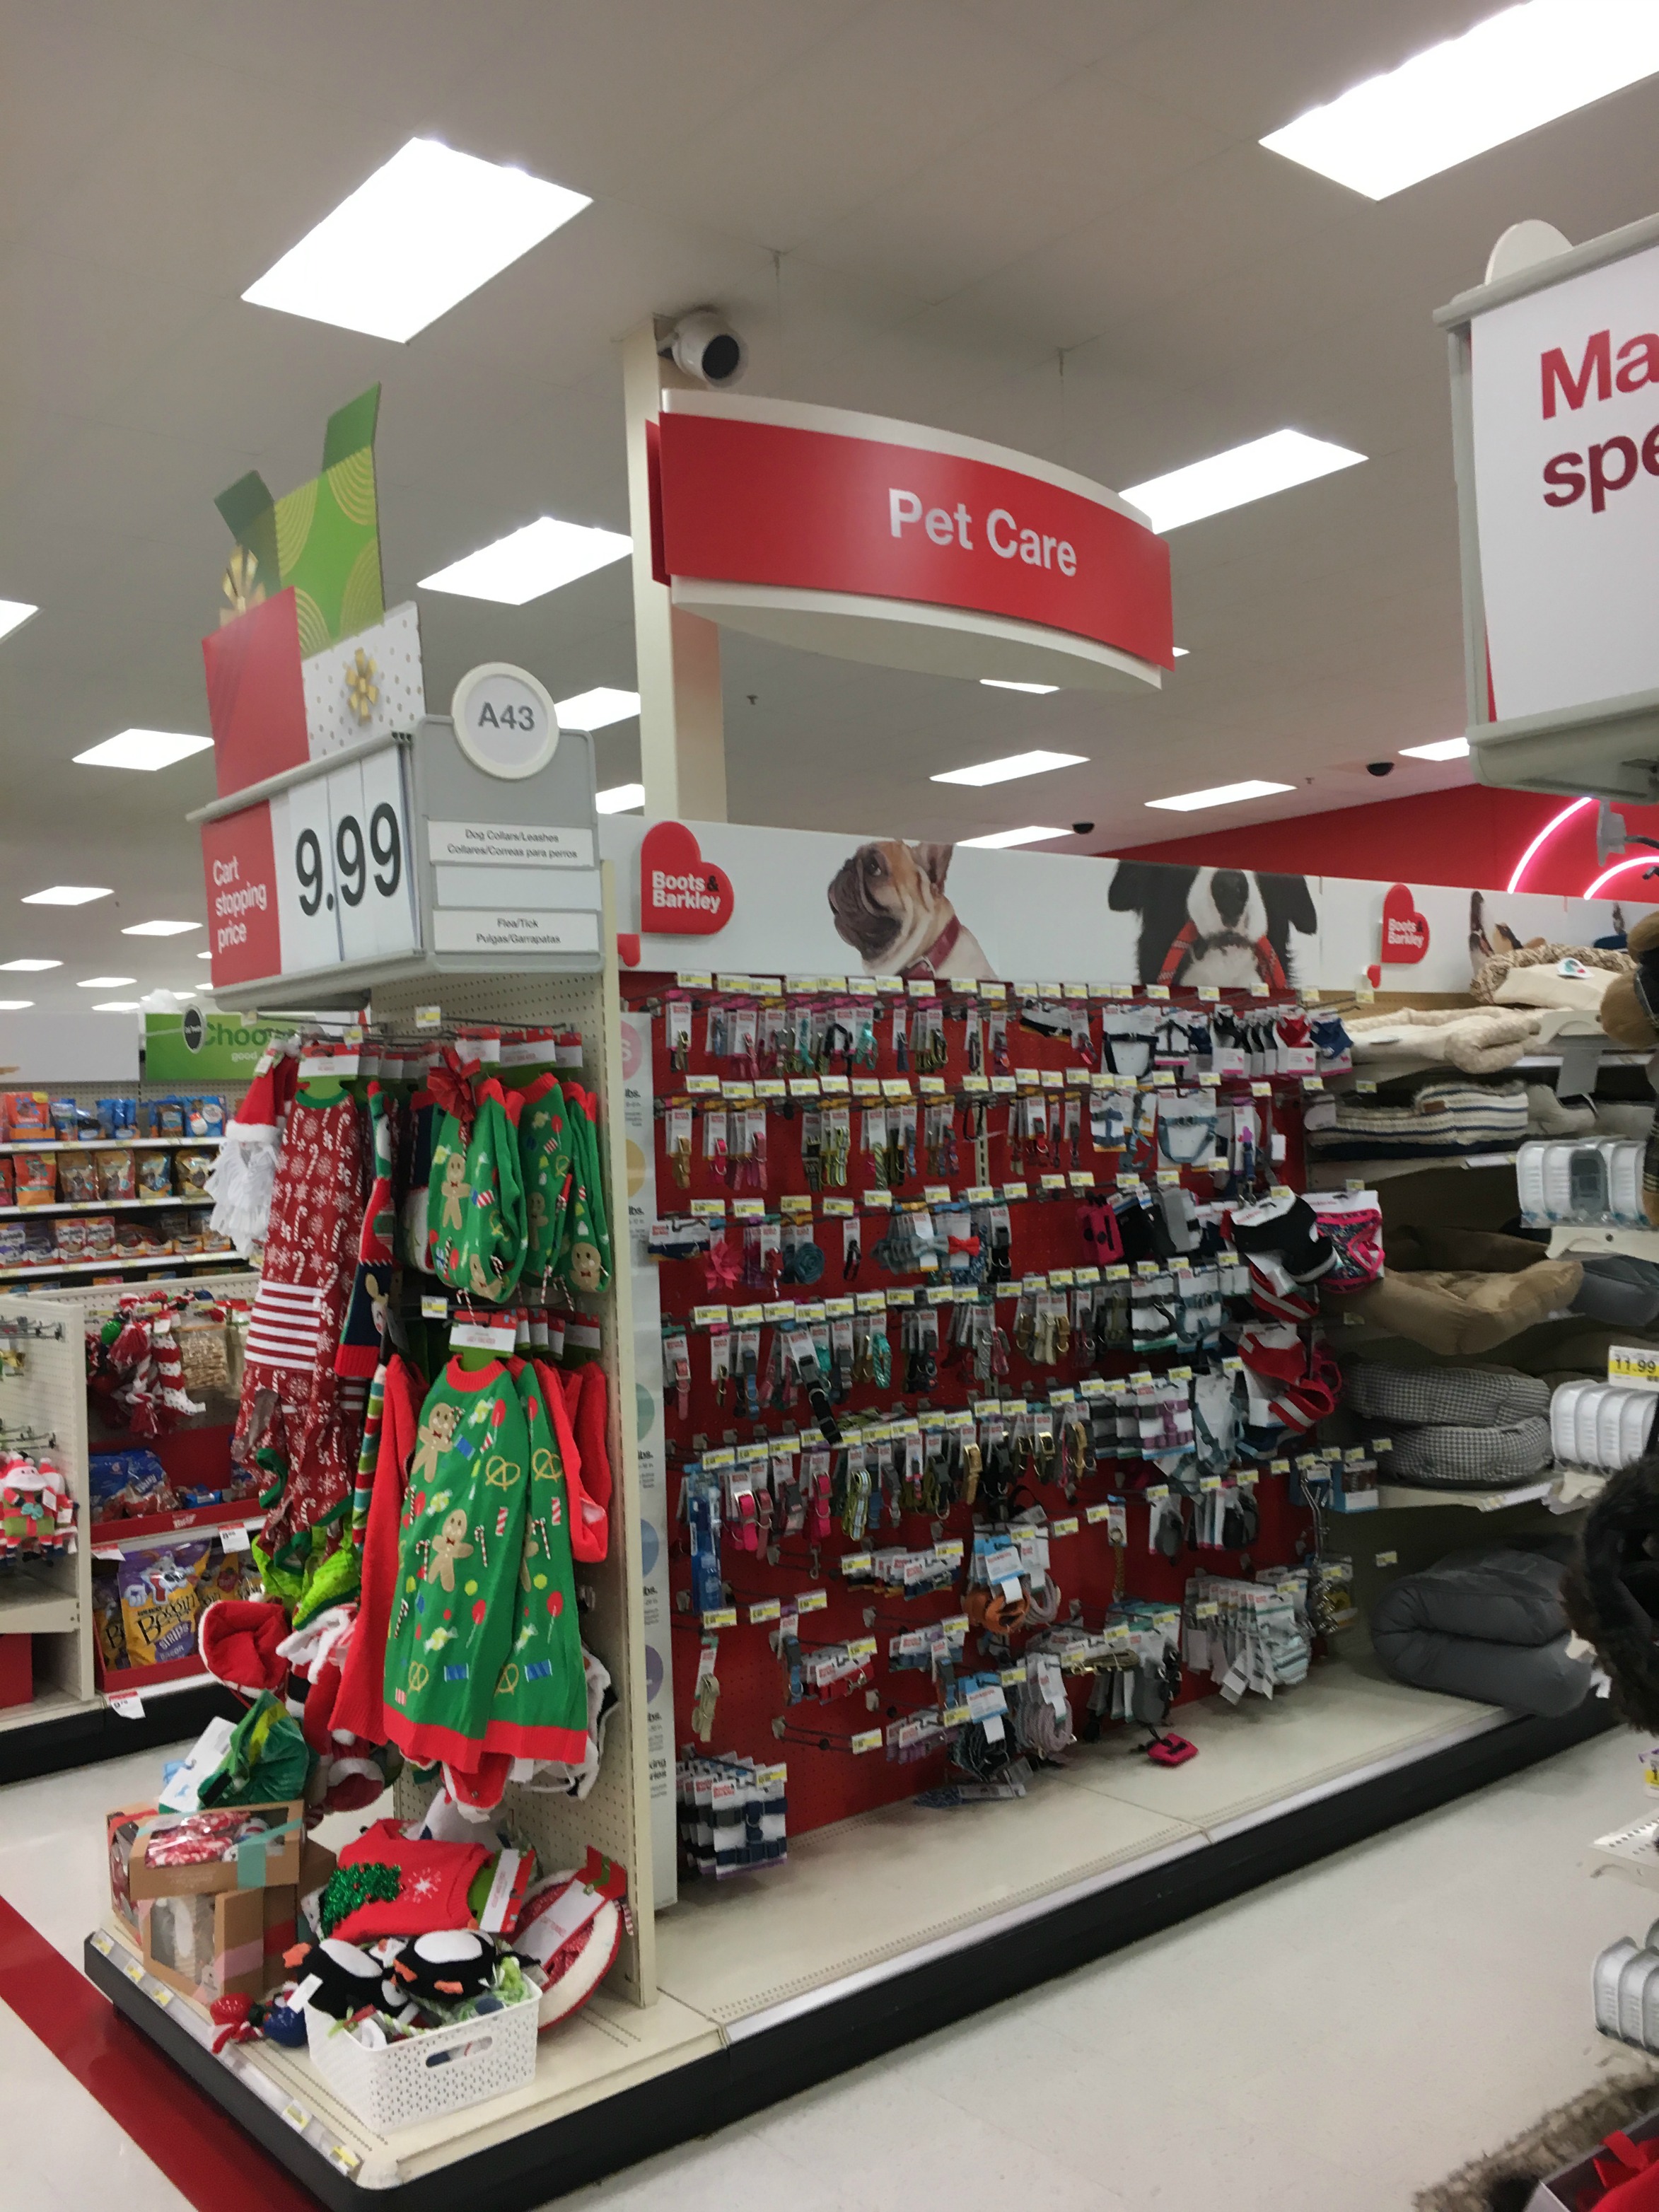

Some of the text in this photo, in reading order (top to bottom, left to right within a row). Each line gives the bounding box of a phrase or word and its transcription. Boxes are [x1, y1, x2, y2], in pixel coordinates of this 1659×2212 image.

[889, 488, 1077, 576] Pet Care
[478, 702, 535, 732] A43
[465, 828, 559, 844] Dog Collars/Leashes
[296, 802, 402, 917] 9.99
[526, 849, 547, 858] para
[549, 849, 578, 859] perros
[213, 855, 240, 886] Cart
[652, 870, 720, 892] Boots &
[215, 880, 268, 917] stopping
[652, 889, 721, 914] Barkley
[497, 917, 540, 929] Flea/Tick
[1388, 918, 1416, 933] Boots
[217, 919, 247, 954] price
[476, 933, 561, 945] Pulgas/Garrapatas
[1387, 930, 1424, 948] Barkley
[231, 1051, 258, 1063] good
[1614, 1354, 1656, 1373] 11.99
